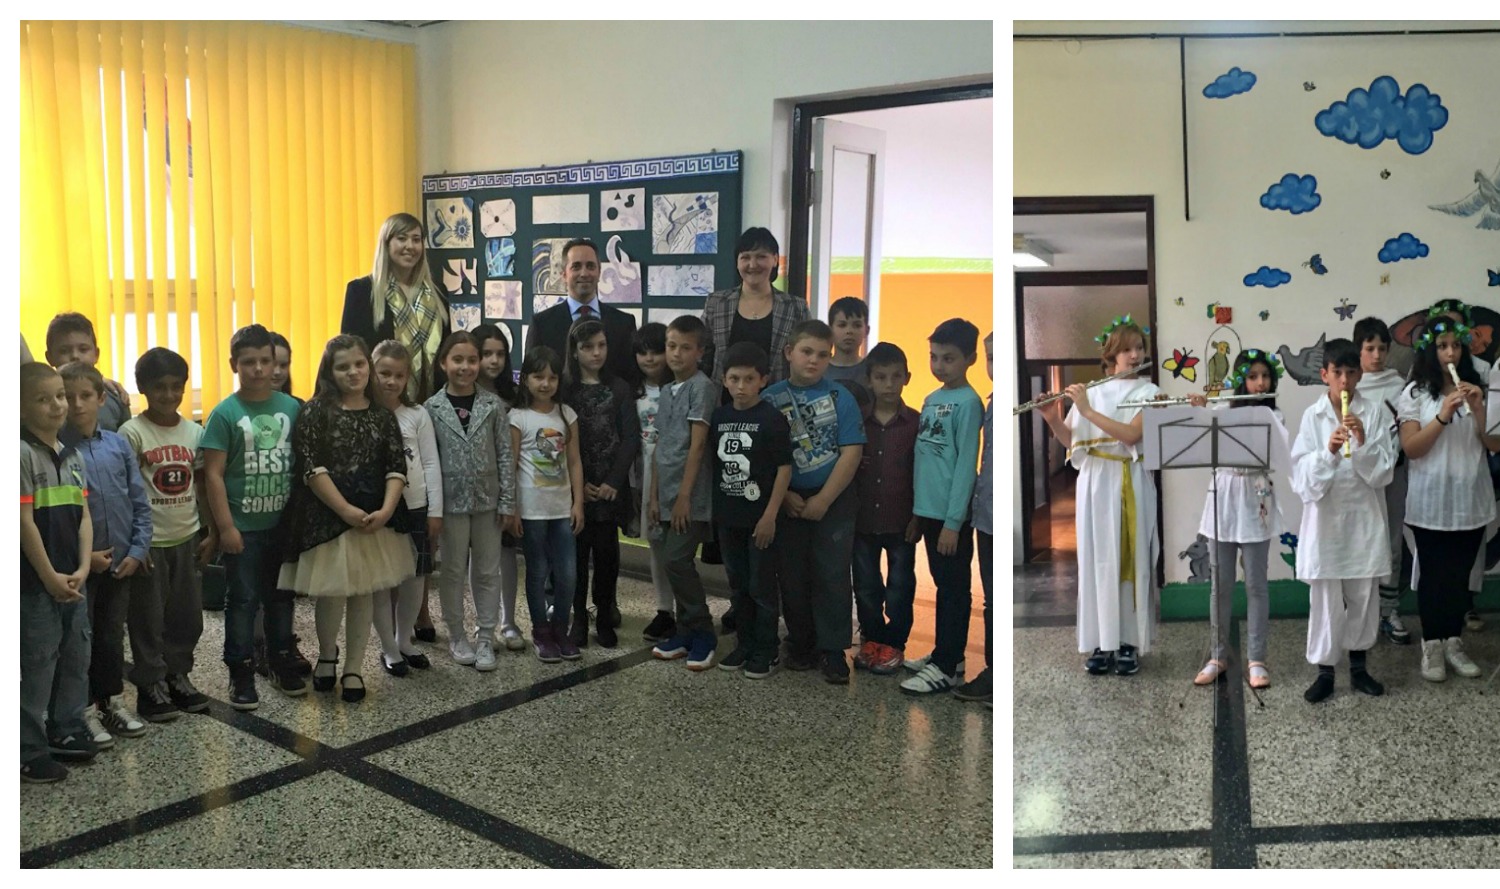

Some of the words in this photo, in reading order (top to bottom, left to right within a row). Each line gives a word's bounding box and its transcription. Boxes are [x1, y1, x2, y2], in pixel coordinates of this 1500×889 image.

[726, 440, 739, 452] 19
[245, 448, 291, 474] BEST
[168, 471, 181, 482] 21
